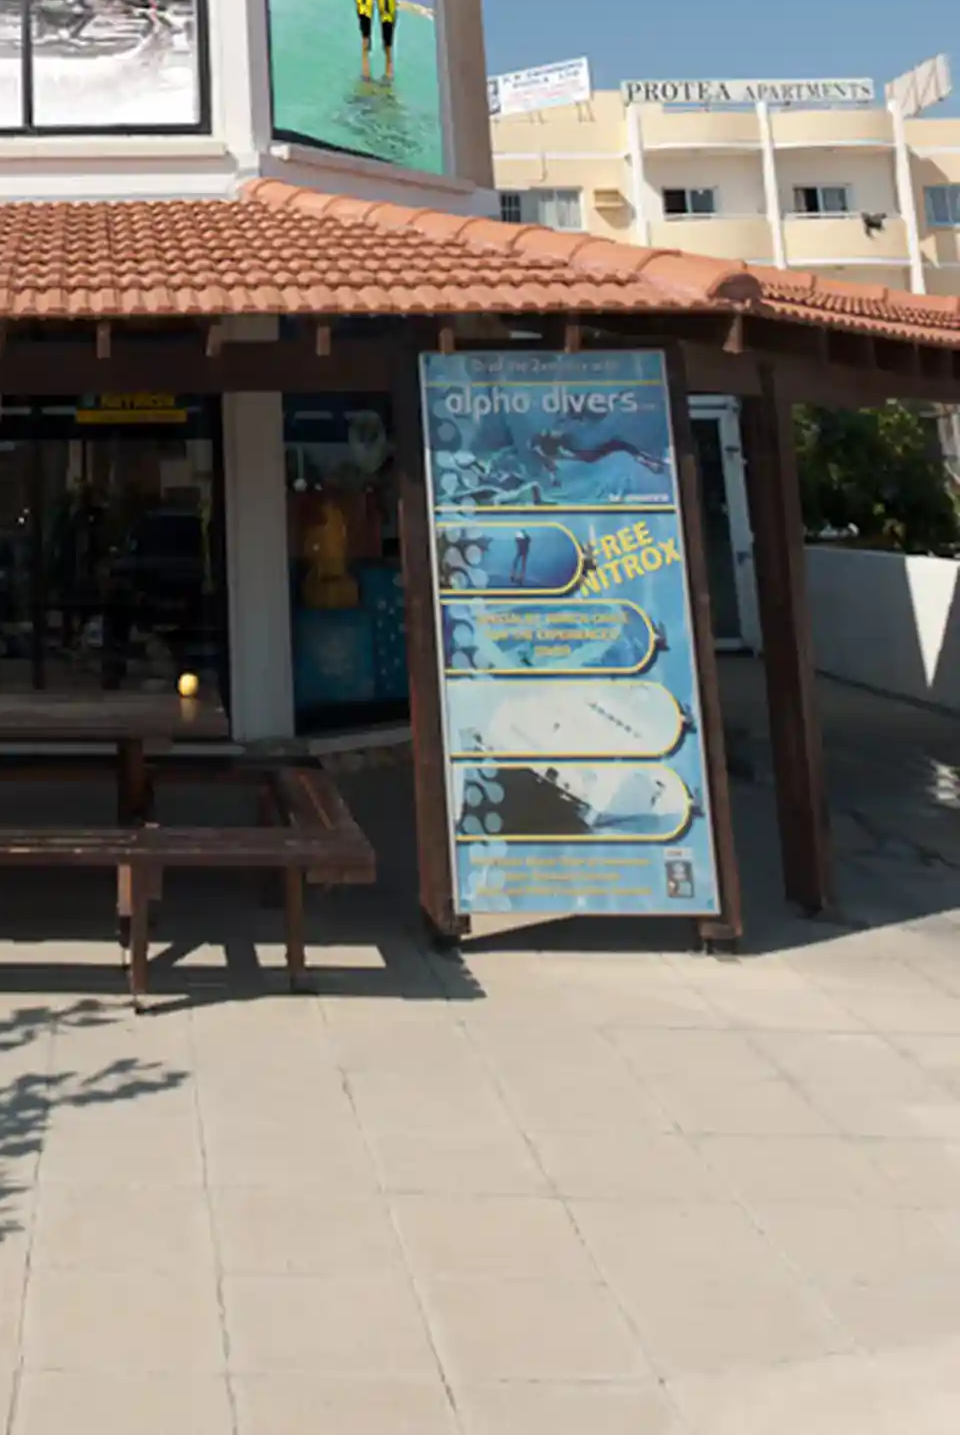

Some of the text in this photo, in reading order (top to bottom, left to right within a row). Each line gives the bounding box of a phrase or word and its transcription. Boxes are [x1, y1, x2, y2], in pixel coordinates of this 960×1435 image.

[626, 79, 872, 102] PROTEA APARTMENTS
[444, 386, 638, 422] alpha divers
[580, 537, 681, 597] NITROX
